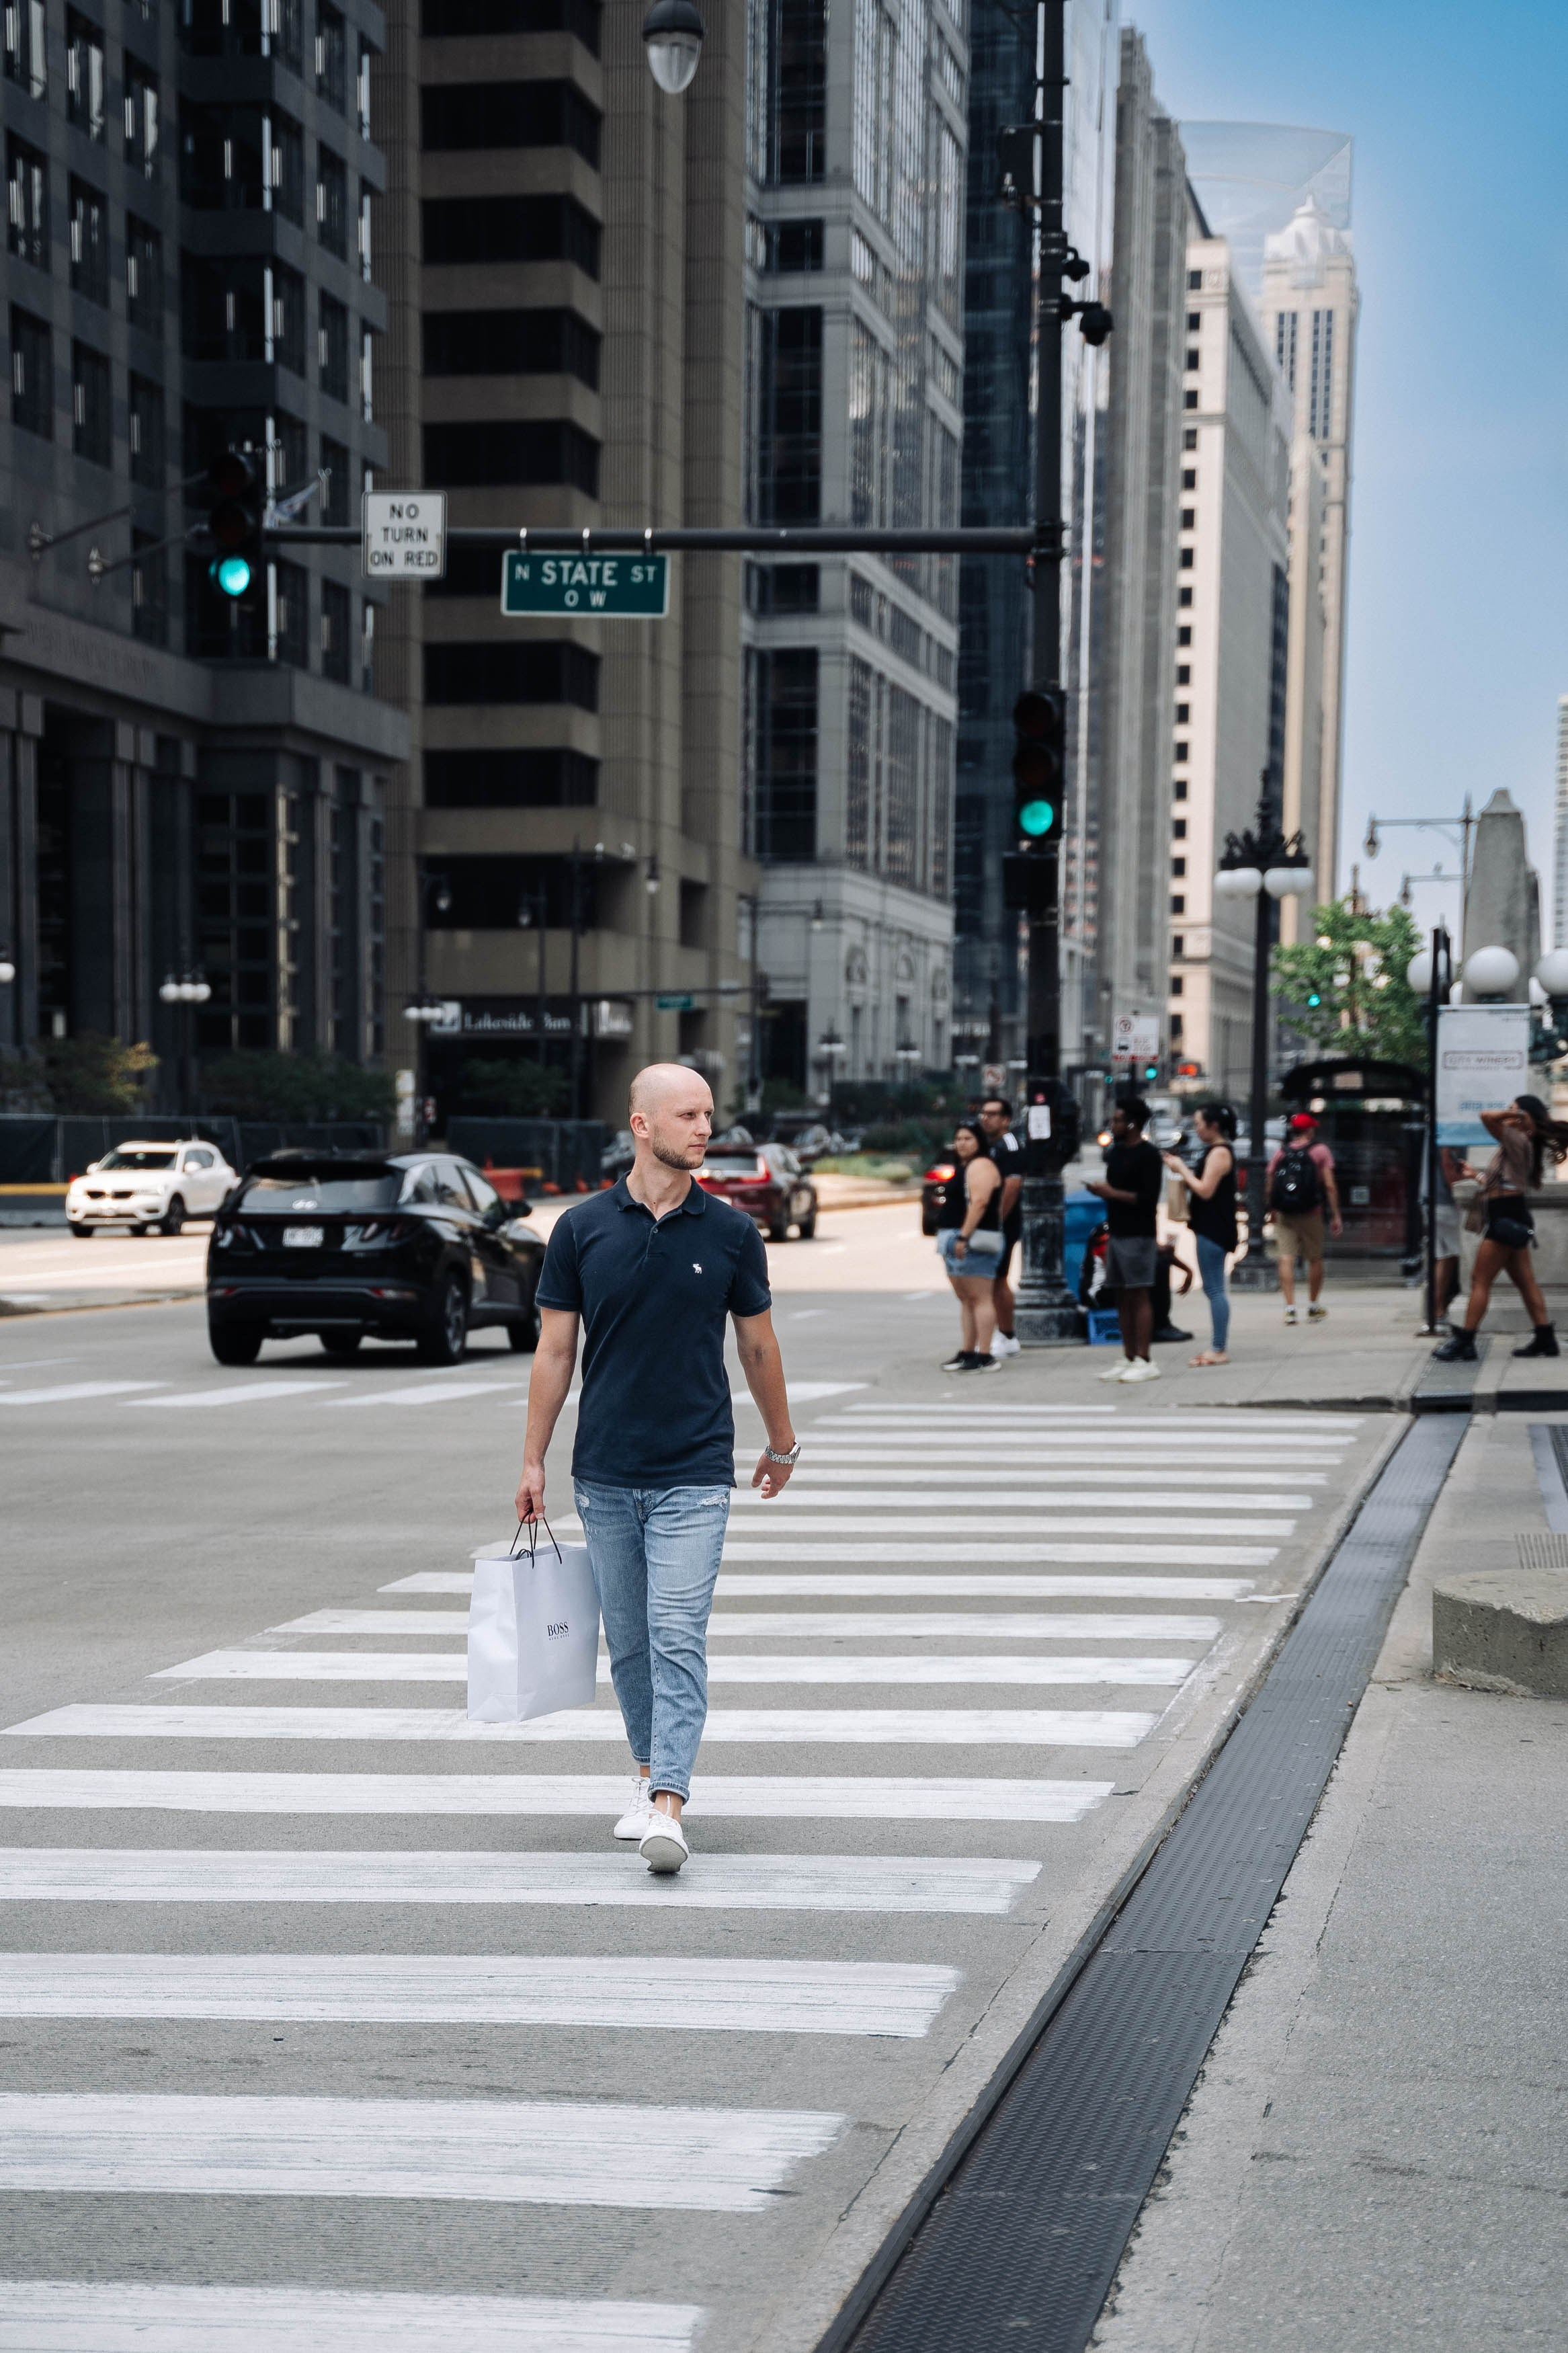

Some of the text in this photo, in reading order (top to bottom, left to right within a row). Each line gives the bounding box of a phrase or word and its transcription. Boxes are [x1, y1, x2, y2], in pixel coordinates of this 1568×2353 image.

[389, 503, 420, 520] NO
[380, 526, 429, 544] TURN
[370, 550, 438, 567] ON RED
[514, 559, 658, 587] N STATE ST
[564, 589, 607, 608] O W
[547, 1621, 569, 1636] BOSS
